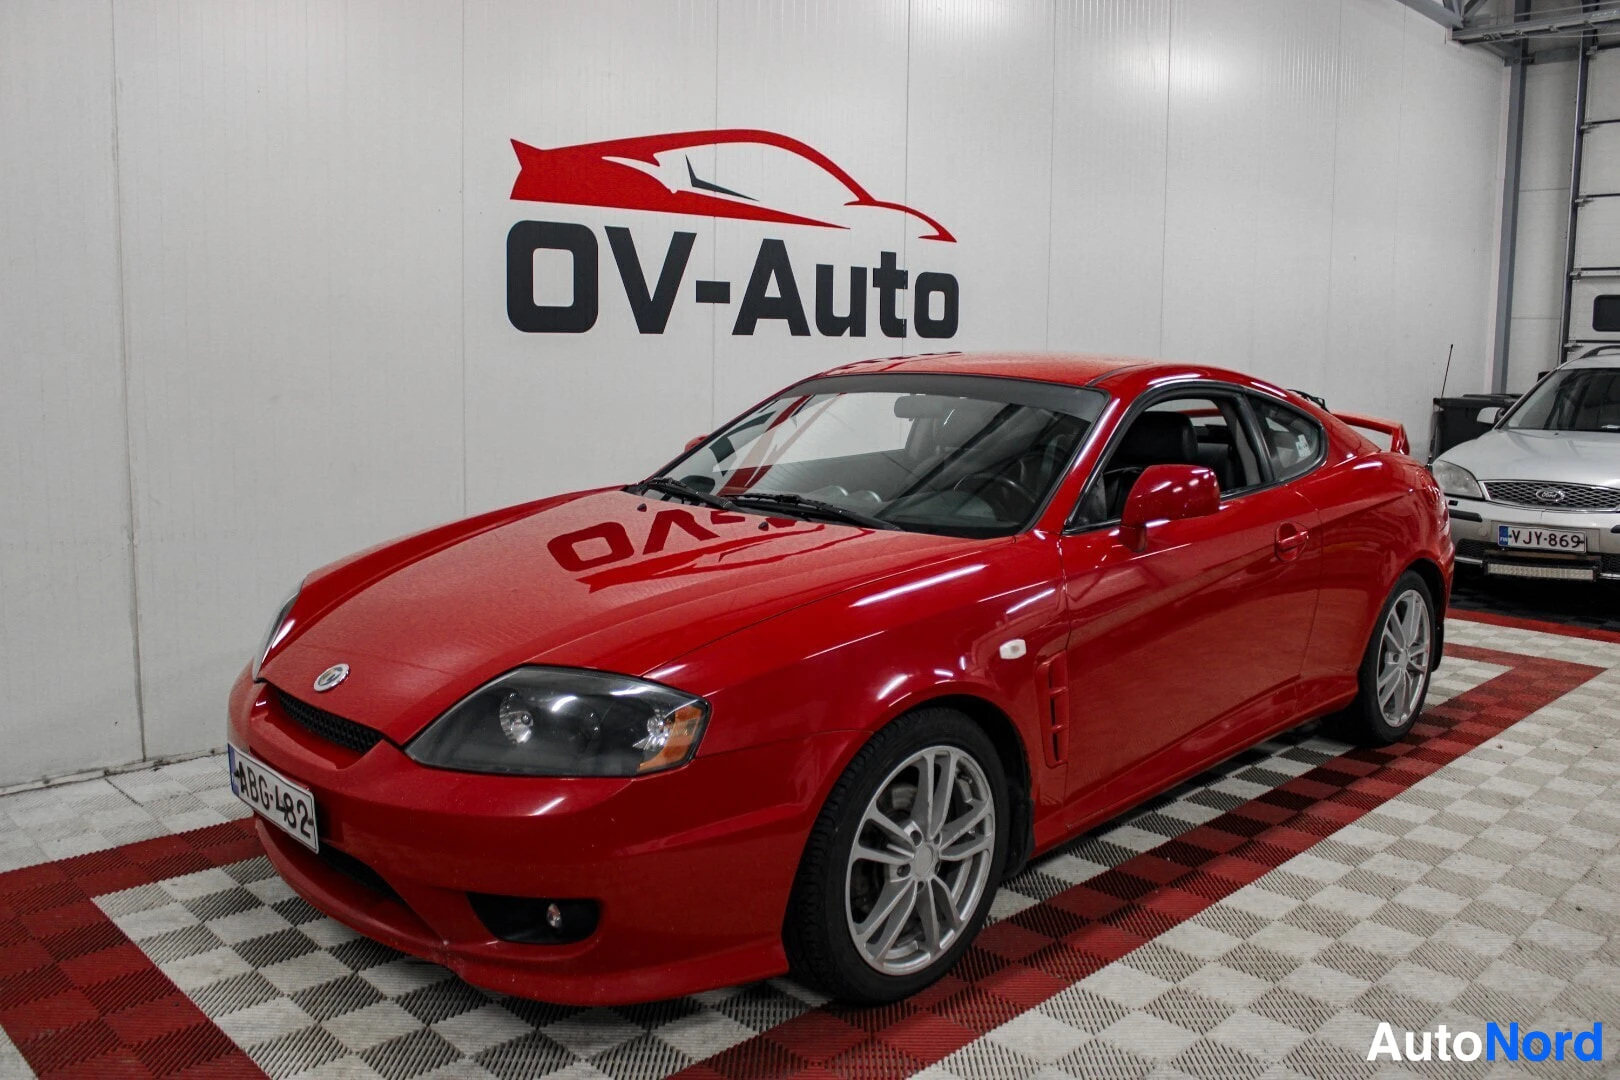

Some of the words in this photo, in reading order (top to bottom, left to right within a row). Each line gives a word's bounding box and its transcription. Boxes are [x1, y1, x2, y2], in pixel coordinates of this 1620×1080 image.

[506, 219, 959, 339] OV-Auto
[1511, 529, 1581, 548] VJY-869
[238, 760, 311, 839] ABG-482
